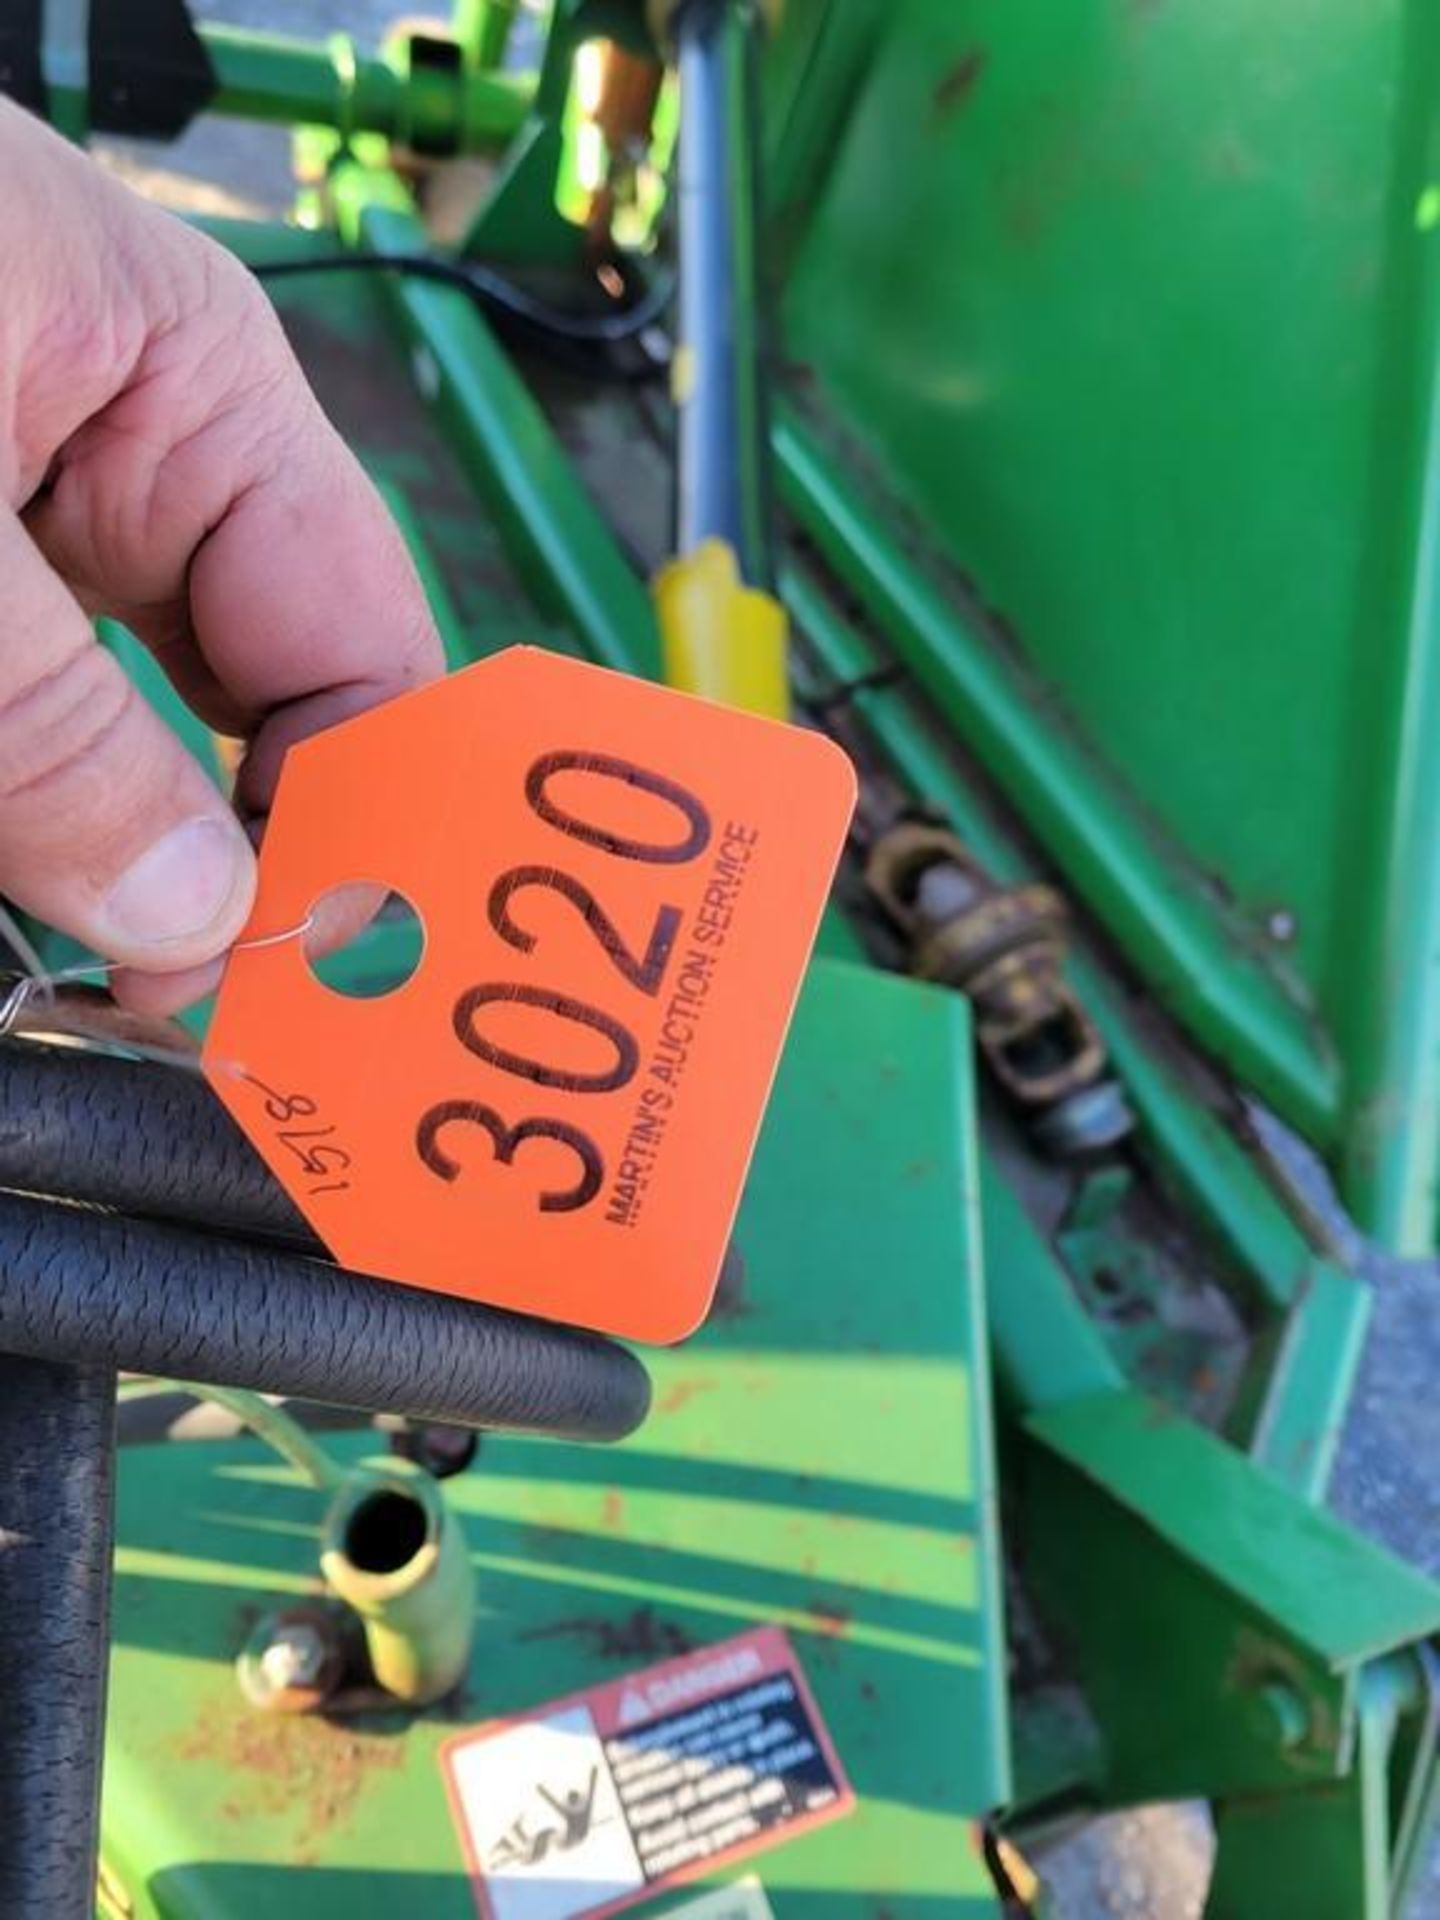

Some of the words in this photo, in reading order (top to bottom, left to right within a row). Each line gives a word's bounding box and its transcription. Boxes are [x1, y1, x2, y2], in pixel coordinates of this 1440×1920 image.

[416, 750, 711, 1212] 3020
[605, 1089, 673, 1228] MARTIN'S
[649, 953, 717, 1088] AUCTION
[693, 821, 757, 950] SERVICE
